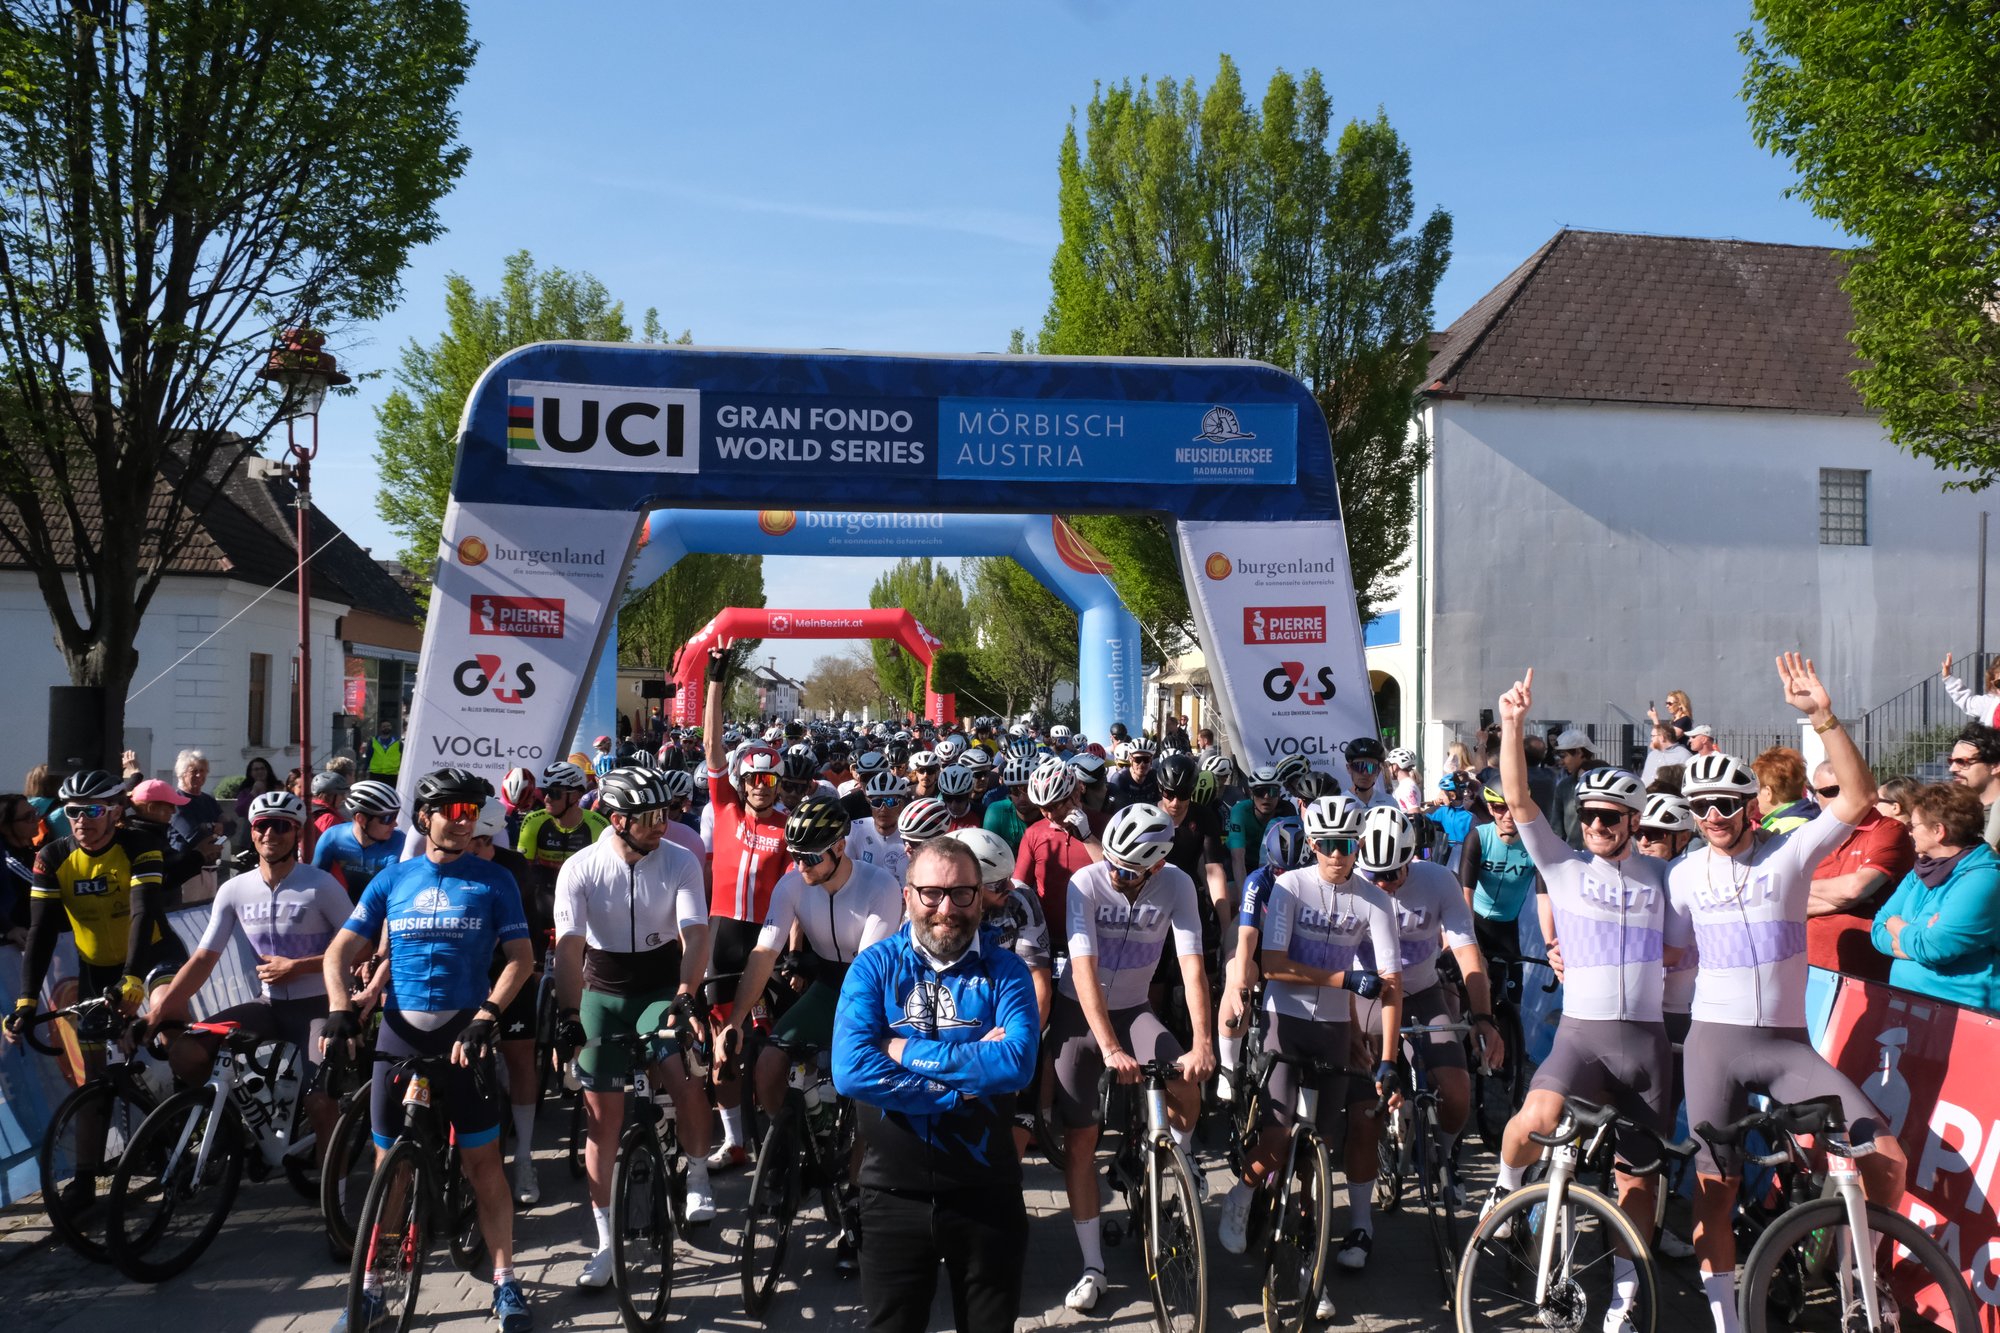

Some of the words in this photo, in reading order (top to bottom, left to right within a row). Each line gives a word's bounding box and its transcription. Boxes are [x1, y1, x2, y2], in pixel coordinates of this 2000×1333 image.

[542, 397, 684, 457] UCI
[717, 405, 800, 429] GRAN
[810, 408, 913, 432] FONDO
[959, 408, 1124, 437] MÖRBISCH
[716, 436, 822, 461] WORLD
[829, 440, 925, 464] SERIES
[957, 443, 1083, 467] AUSTRIA
[1175, 448, 1273, 463] NEUSIEDLERSEE
[1193, 467, 1254, 475] RADMARATHON
[805, 511, 944, 534] burgenland
[495, 543, 605, 566] burgenland
[1237, 557, 1335, 578] burgenland
[500, 607, 560, 623] PIERRE
[795, 618, 863, 628] MeinBezirk.at
[1269, 617, 1322, 631] PIERRE
[500, 623, 560, 634] BAGUETTE
[1270, 631, 1323, 640] BAGUETTE
[453, 654, 536, 704] G4S
[1105, 638, 1129, 721] rgenland
[1263, 662, 1337, 705] G4S
[687, 678, 698, 723] REGION.
[432, 736, 543, 759] VOGL+CO
[1264, 736, 1349, 756] VOGL+C
[457, 761, 471, 769] wie
[485, 762, 505, 770] willst
[1481, 860, 1529, 877] BEAT
[76, 880, 107, 894] RL
[1243, 881, 1260, 914] BMC
[1583, 875, 1657, 907] RH77
[243, 901, 304, 920] RH77
[1098, 903, 1163, 925] RH77
[1301, 906, 1359, 930] RH77
[390, 917, 482, 932] NEUSIEDLERSEE
[1272, 899, 1287, 947] BMC
[911, 1059, 940, 1069] RH77
